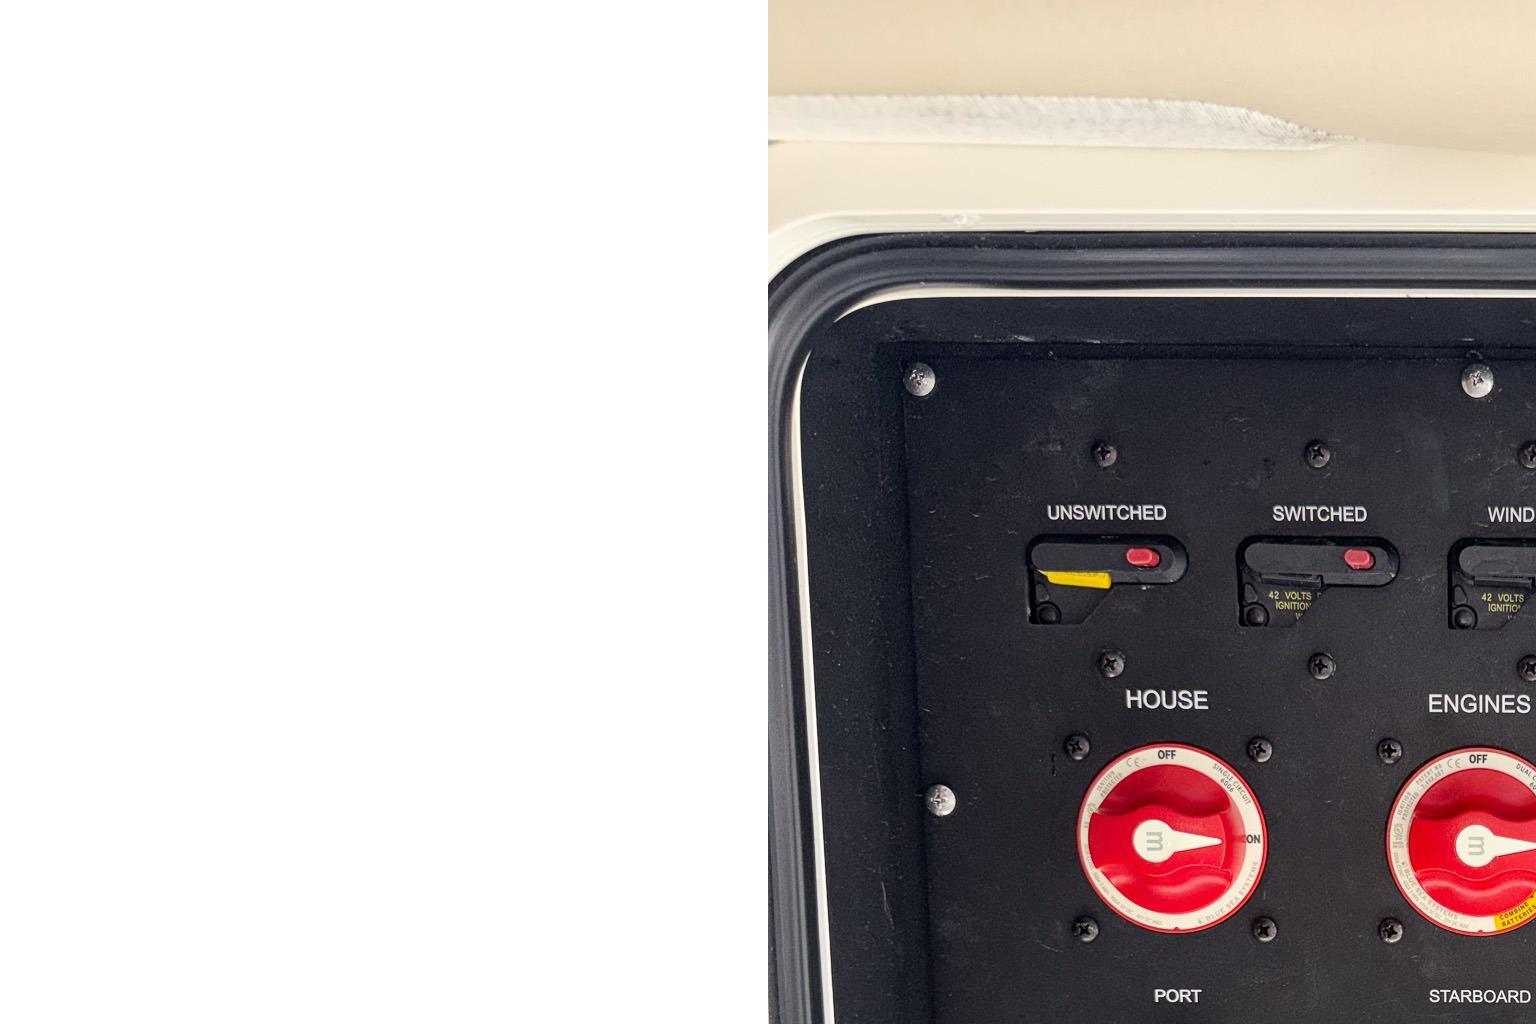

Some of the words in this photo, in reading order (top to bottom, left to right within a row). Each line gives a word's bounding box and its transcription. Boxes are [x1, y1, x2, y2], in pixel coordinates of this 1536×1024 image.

[1047, 504, 1167, 521] UNSWITCHED
[1272, 505, 1368, 522] SWITCHED
[1268, 590, 1280, 600] 42
[1284, 591, 1312, 601] VOLTS
[1481, 593, 1493, 602] 42
[1497, 593, 1525, 603] VOLTS
[1488, 603, 1521, 613] IGNITIO
[1125, 689, 1209, 710] HOUSE
[1428, 693, 1531, 714] ENGINES
[1157, 749, 1177, 761] OFF
[1468, 753, 1488, 765] OFF
[1514, 762, 1532, 779] DUAL
[1211, 762, 1235, 783] SINGLE
[1232, 779, 1252, 805] CIRCUIT
[1246, 833, 1262, 845] ON
[1499, 901, 1530, 921] COMBINE
[1154, 988, 1203, 1003] PORT
[1429, 989, 1532, 1004] STARBOARD
